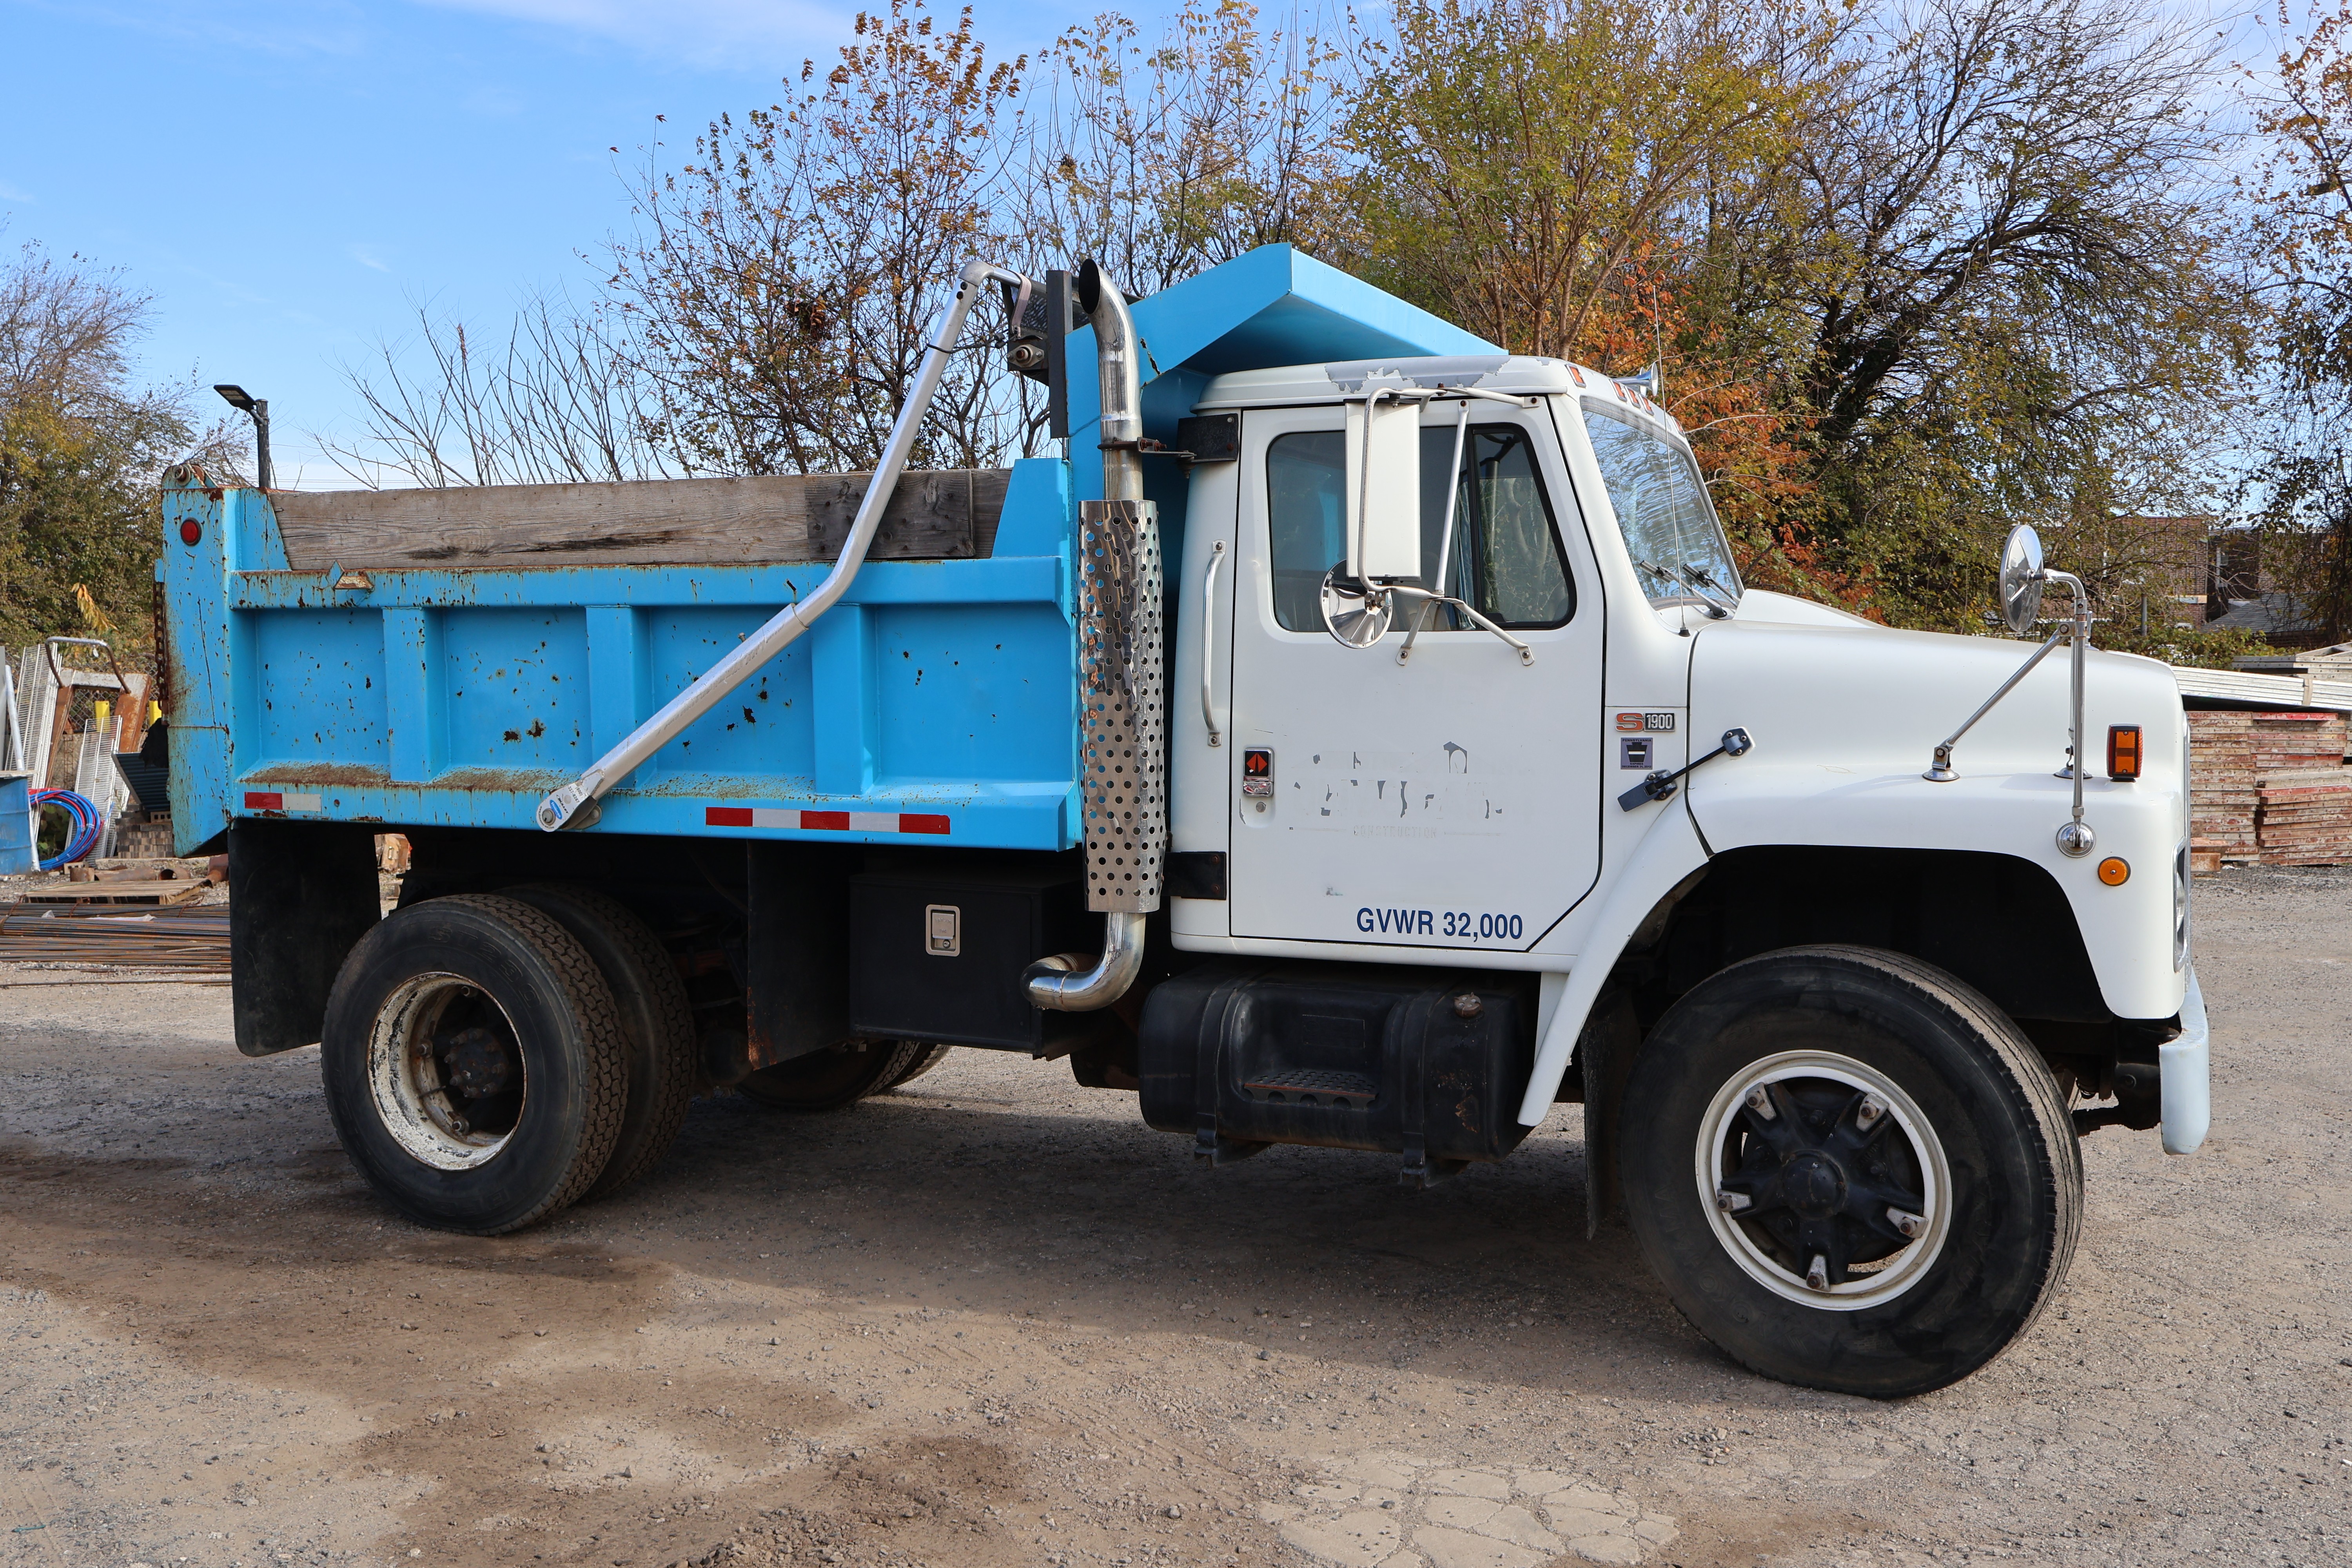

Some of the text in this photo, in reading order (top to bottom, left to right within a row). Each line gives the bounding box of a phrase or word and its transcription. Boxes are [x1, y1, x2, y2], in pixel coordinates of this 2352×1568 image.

[1646, 714, 1673, 729] 1900
[568, 786, 580, 803] 327-8287
[558, 797, 569, 814] BULLET
[1353, 825, 1437, 838] CONSTRUCTION
[1357, 907, 1523, 943] GVWR 32,000
